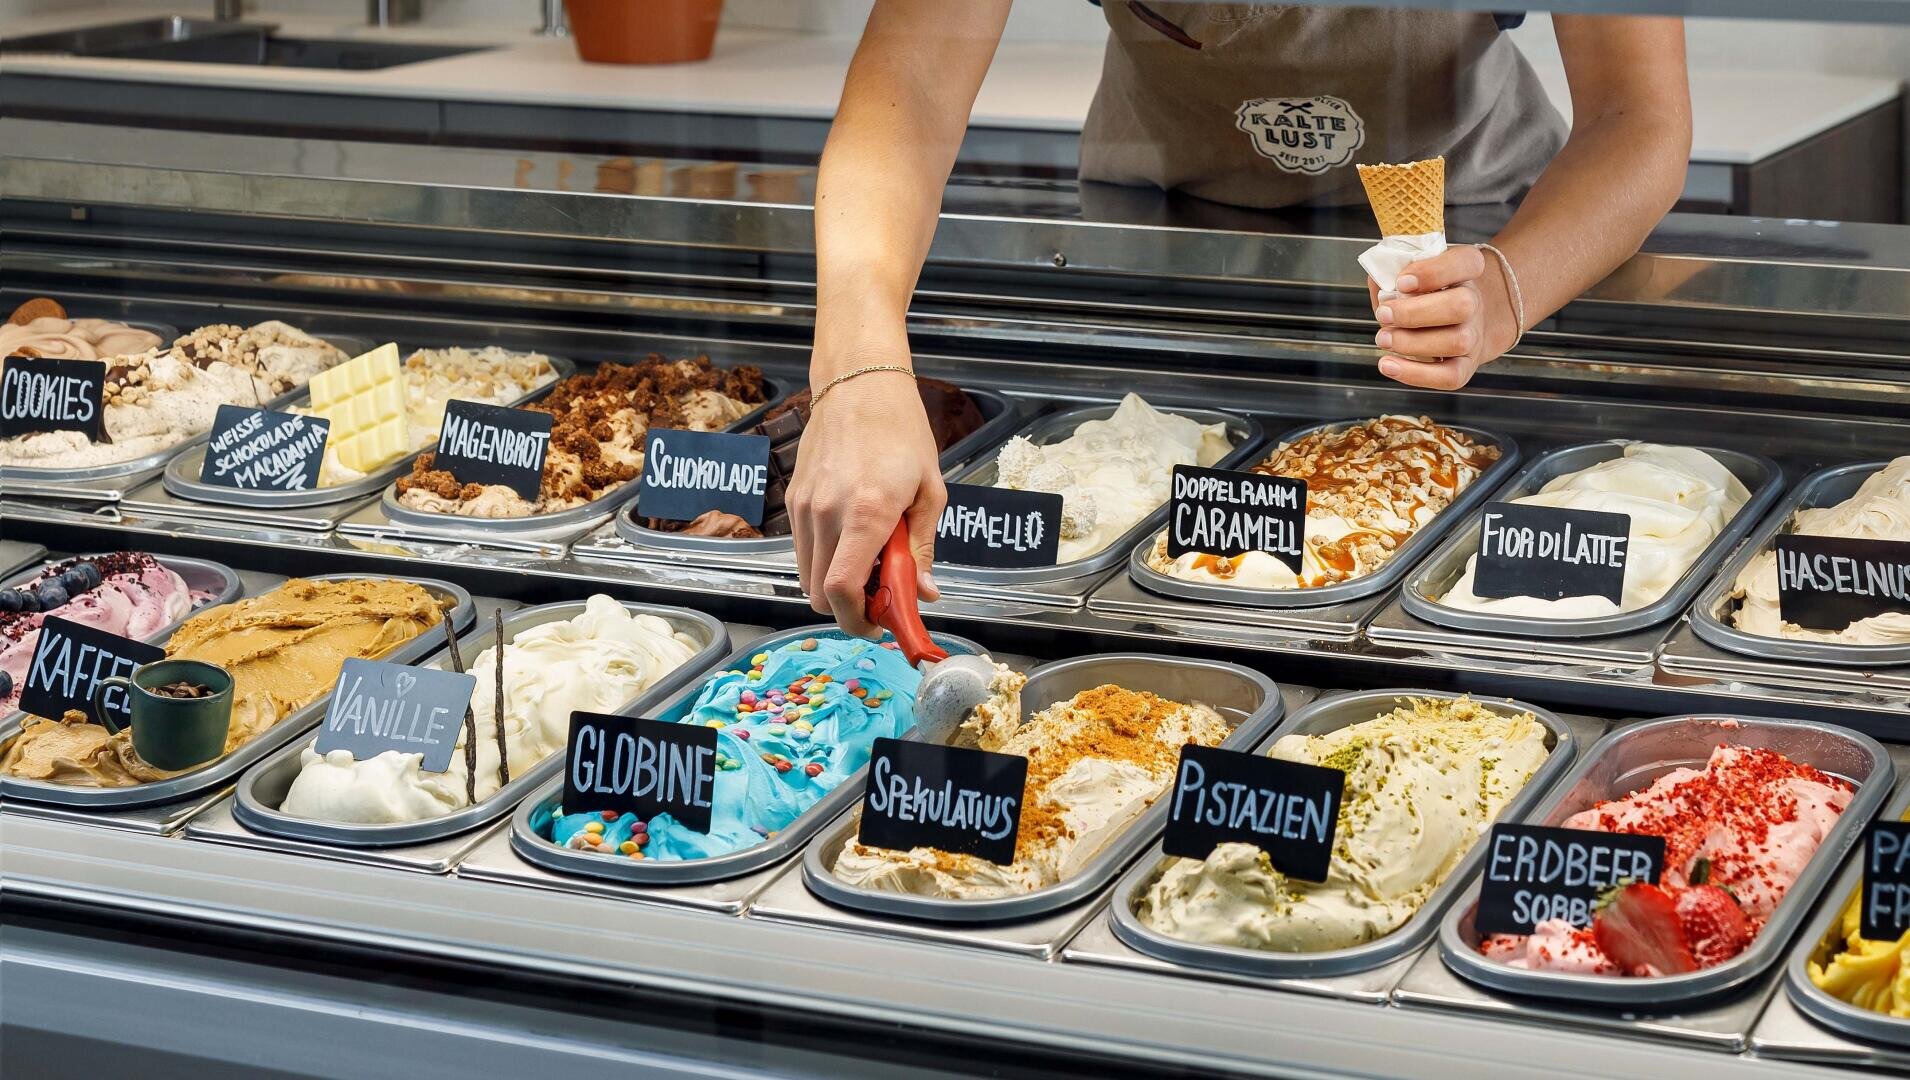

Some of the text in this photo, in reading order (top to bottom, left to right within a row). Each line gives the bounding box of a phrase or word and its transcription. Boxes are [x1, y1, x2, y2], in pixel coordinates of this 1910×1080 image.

[1251, 113, 1346, 131] KALTE
[1265, 128, 1336, 149] LUST
[1278, 151, 1299, 164] SEIT
[1, 367, 94, 421] COOKIES
[210, 411, 263, 453] WEISSE
[214, 415, 305, 476] SCHOKOLADE
[233, 424, 328, 488] MACADAMIA
[439, 412, 550, 471] MAGENBROT
[646, 437, 767, 495] SCHOKOLADE
[1175, 473, 1297, 509] DOPPELRAHM
[937, 505, 1045, 552] AFFAELLO
[1176, 503, 1302, 555] CARAMELL
[329, 672, 449, 744] VANILLE
[572, 724, 714, 808] GLOBINE
[870, 756, 1016, 841] SPEKULATIUS
[1173, 759, 1332, 843] PISTAZIEN
